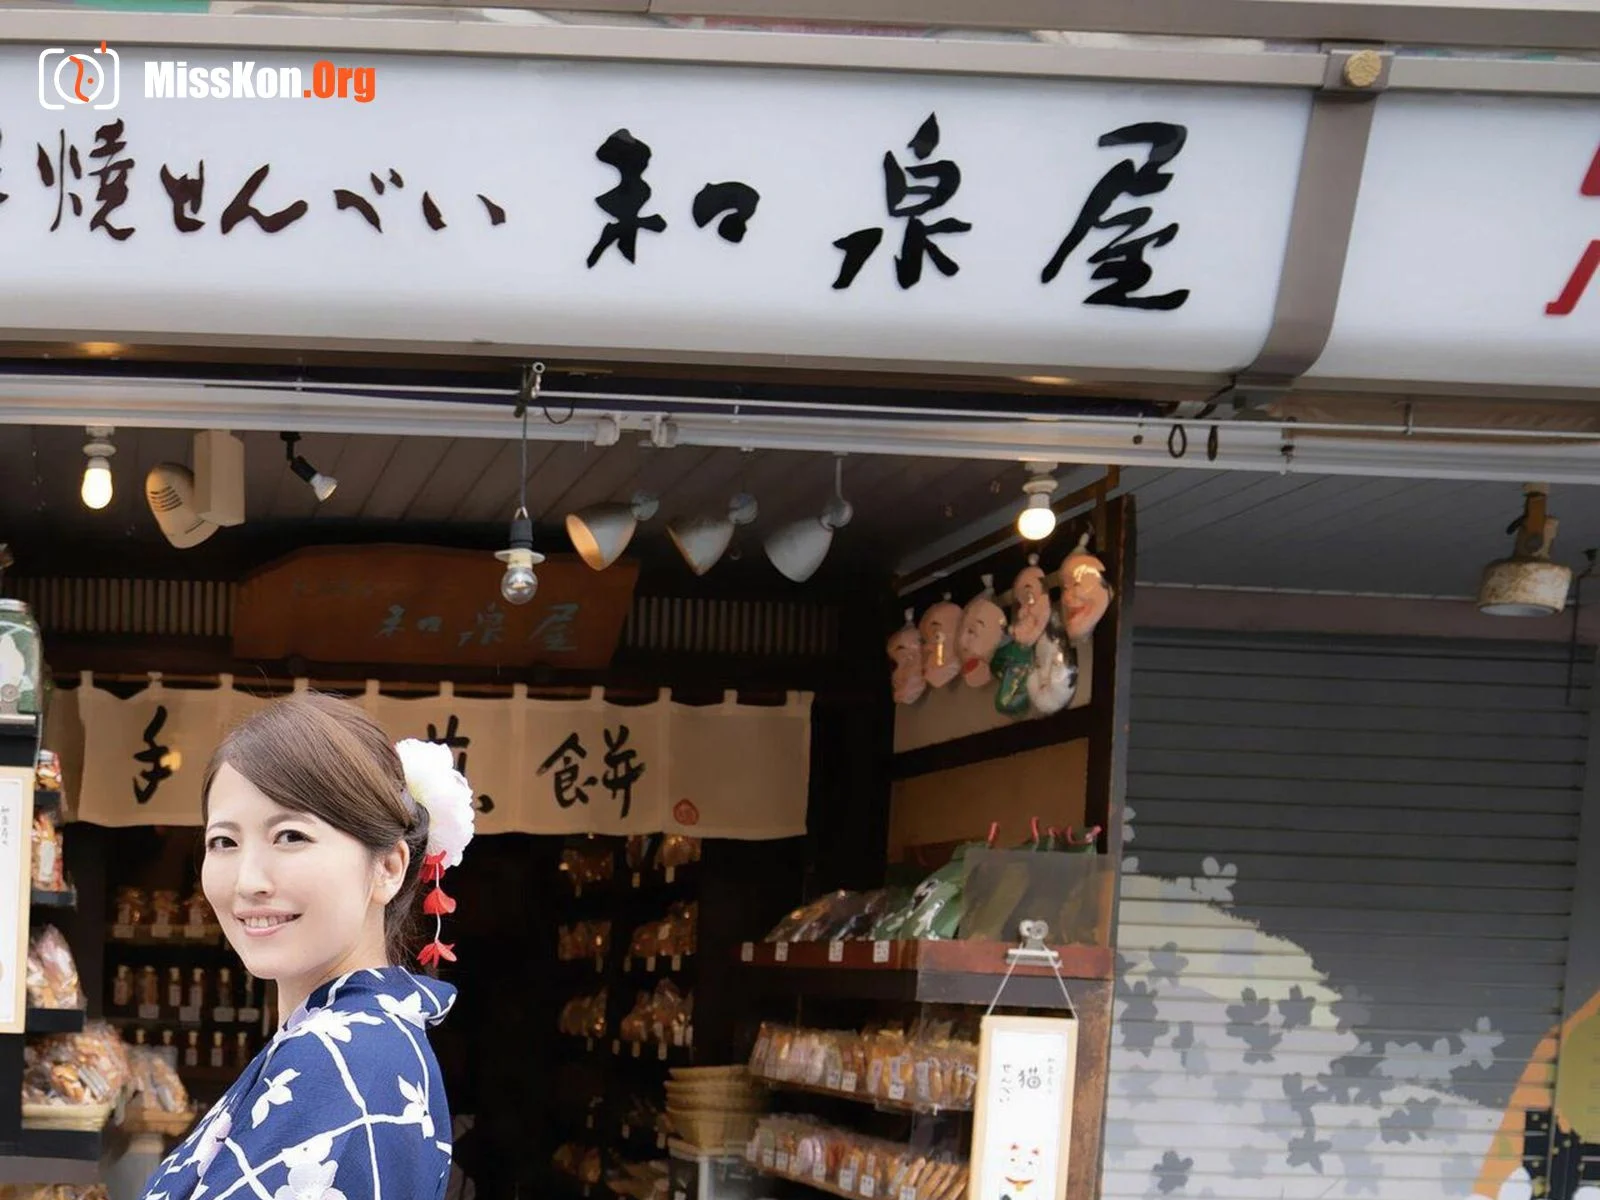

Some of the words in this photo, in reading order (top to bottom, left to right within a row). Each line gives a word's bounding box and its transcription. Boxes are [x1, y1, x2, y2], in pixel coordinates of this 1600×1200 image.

[0, 117, 506, 241] 焼せんべい
